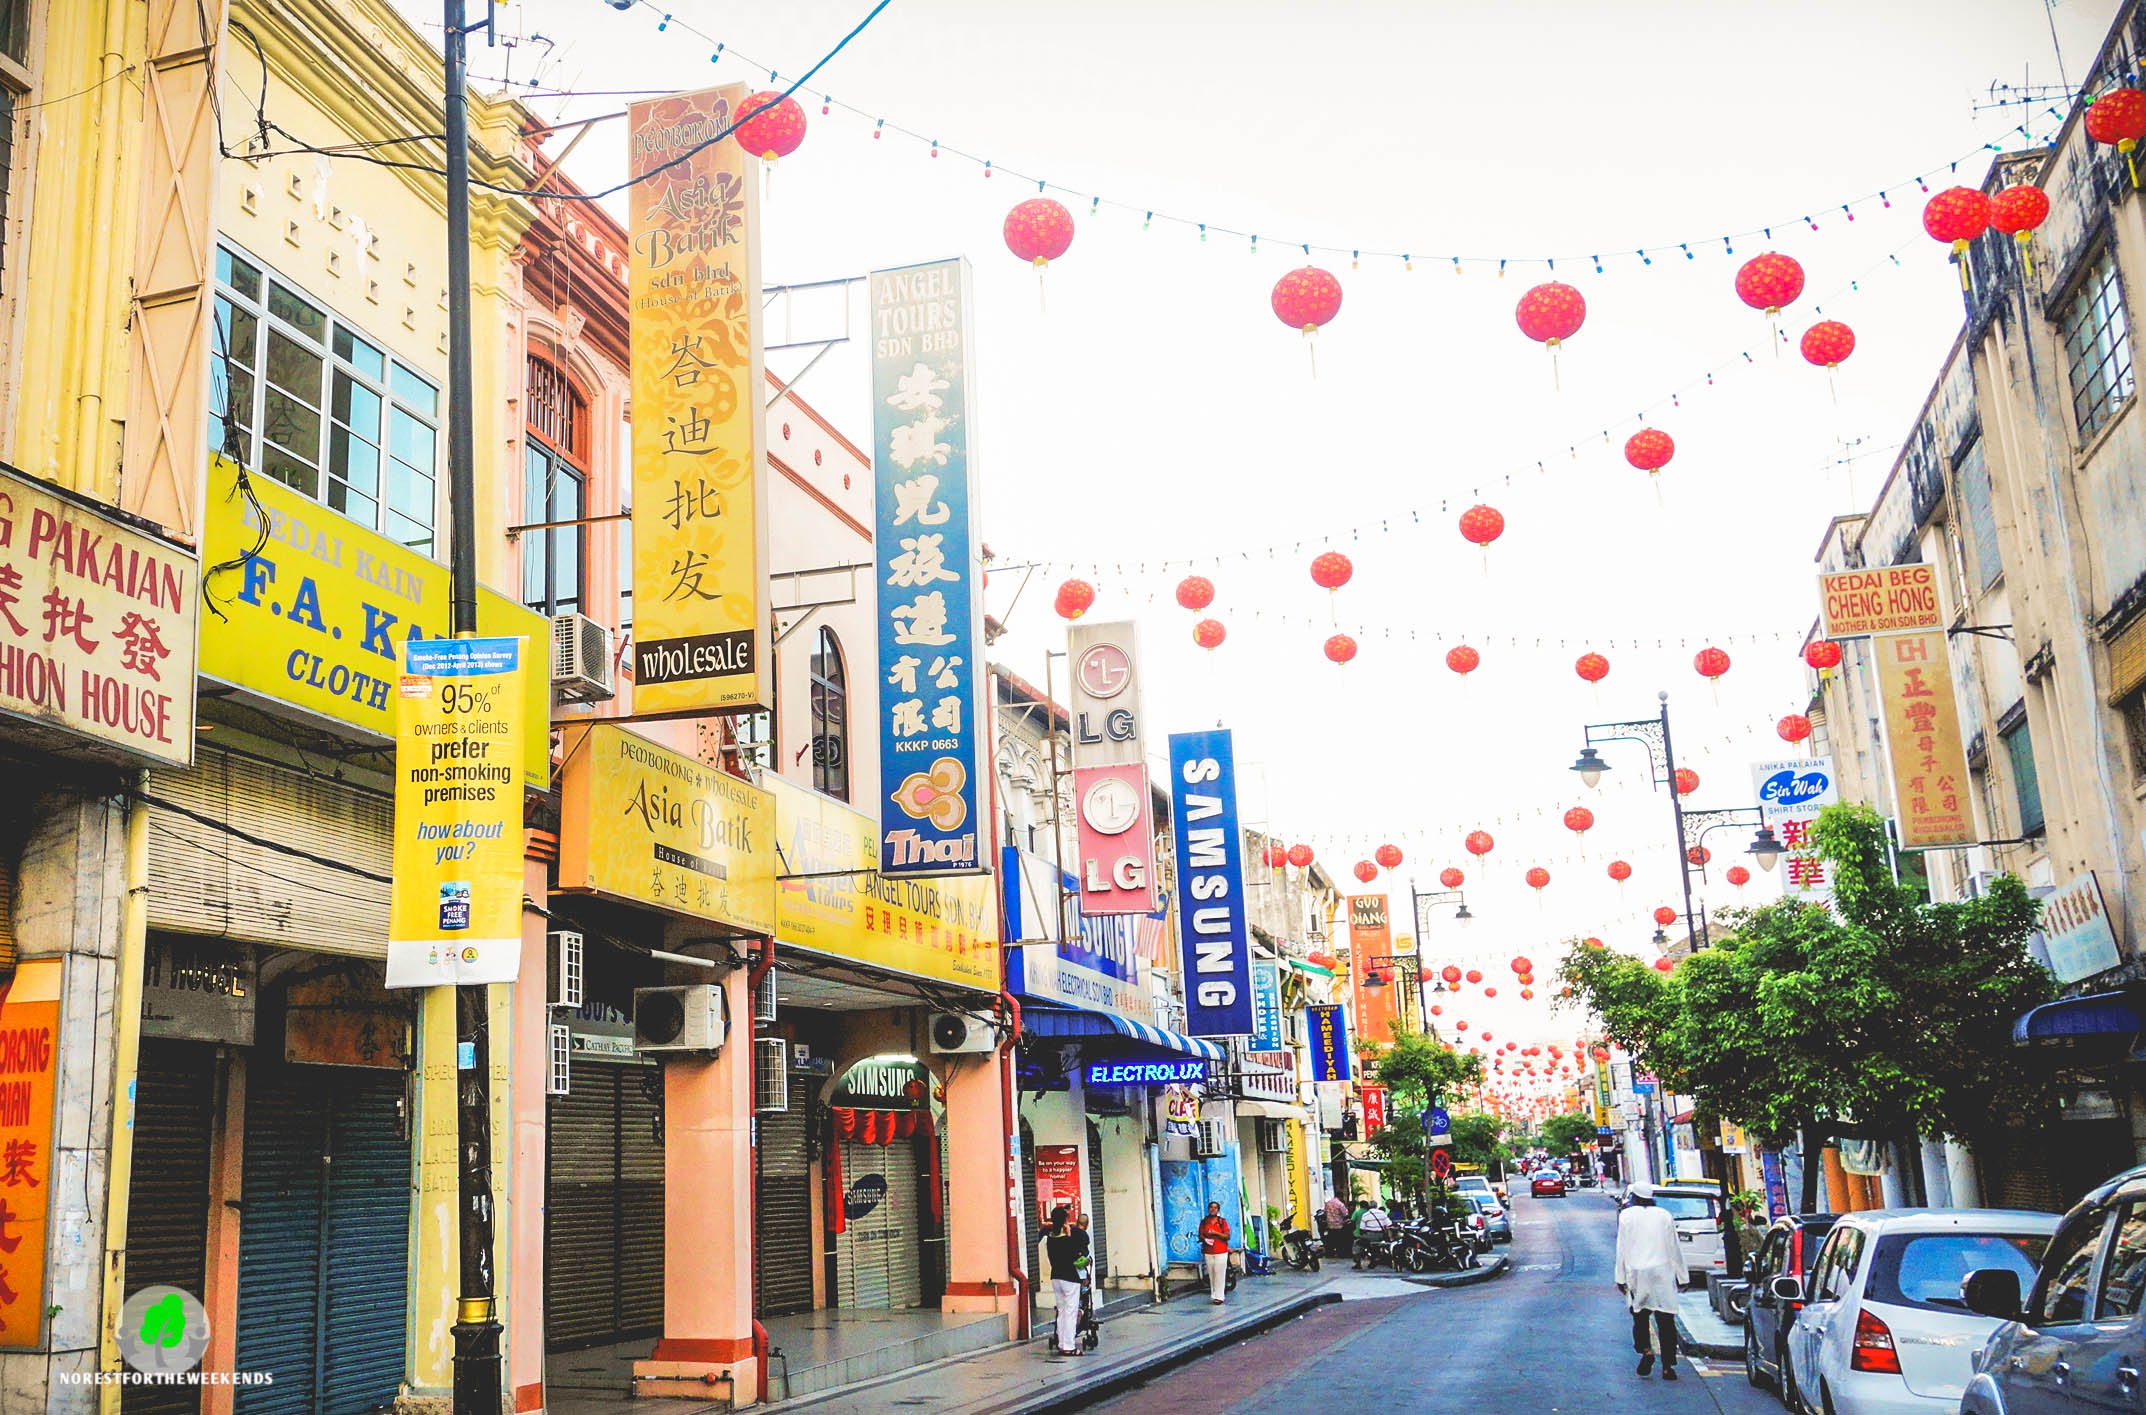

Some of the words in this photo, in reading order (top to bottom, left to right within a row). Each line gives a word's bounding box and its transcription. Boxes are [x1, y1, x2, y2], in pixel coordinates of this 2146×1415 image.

[645, 177, 729, 222] Asia
[635, 215, 743, 269] Batik
[879, 267, 955, 305] ANGEL
[877, 299, 956, 338] TOURS
[877, 336, 912, 359] SDN
[921, 331, 959, 353] BHD
[27, 507, 184, 615] PAKAIAN
[240, 493, 344, 569] KEDAI
[354, 548, 424, 605] KAIN
[237, 548, 342, 640] F.A.
[1825, 572, 1882, 593] KEDAI
[1889, 568, 1930, 586] BEG
[1828, 591, 1883, 619] CHENG
[1888, 586, 1935, 614] HONG
[1831, 619, 1868, 633] MOTHER
[1870, 620, 1876, 630] &
[1879, 617, 1896, 629] SON
[1896, 616, 1917, 627] SDN
[1918, 613, 1937, 626] BHD
[286, 648, 392, 712] CLOTH
[81, 670, 173, 744] HOUSE
[441, 684, 491, 714] 95%
[491, 684, 502, 695] of
[414, 722, 458, 736] owners
[460, 725, 466, 734] &
[468, 719, 508, 734] clients
[1078, 708, 1136, 744] LG
[431, 736, 490, 765] prefer
[895, 741, 928, 752] KKKP
[931, 738, 959, 750] 0663
[411, 763, 511, 785] non-smoking
[1766, 781, 1790, 799] Sin
[1790, 778, 1823, 796] Wah
[424, 784, 496, 807] premises
[1768, 805, 1793, 814] SHIRT
[1797, 803, 1824, 813] STOR
[417, 821, 451, 840] how
[452, 819, 503, 839] about
[624, 778, 683, 834] Asia
[691, 799, 752, 854] Batik
[435, 841, 475, 865] you?
[658, 846, 686, 868] House
[863, 836, 878, 859] PEL
[885, 828, 975, 867] Thai
[1085, 855, 1147, 892] LG
[1183, 757, 1236, 1007] SAMSUNG
[865, 871, 904, 908] ANGEL
[905, 880, 941, 919] TOURS
[1355, 897, 1379, 908] GUO
[1320, 1011, 1336, 1080] HAMEEDIYAH
[1091, 1063, 1204, 1083] ELECTROLUX
